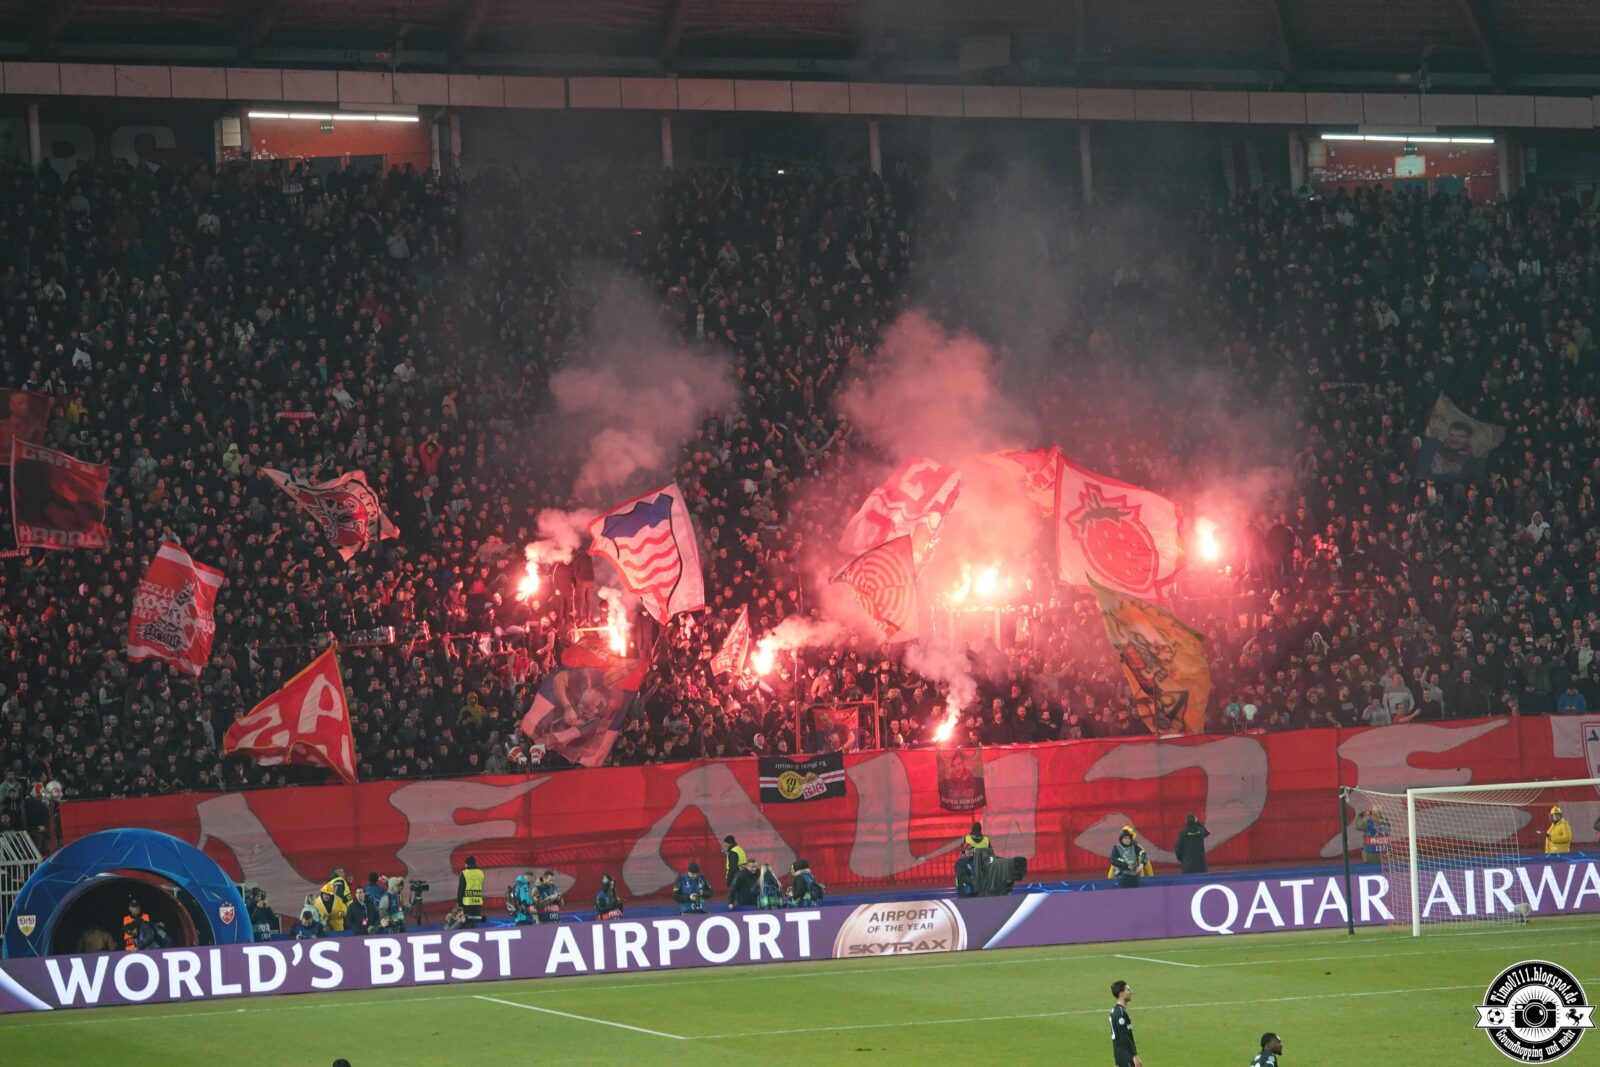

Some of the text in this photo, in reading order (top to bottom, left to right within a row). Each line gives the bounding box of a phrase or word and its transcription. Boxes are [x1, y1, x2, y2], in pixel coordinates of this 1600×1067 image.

[1191, 875, 1395, 935] QATAR
[869, 908, 938, 923] AIRPORT
[867, 922, 934, 934] OF THE YEAR
[364, 930, 522, 985] BEST
[546, 911, 821, 974] AIRPORT
[848, 939, 946, 955] SKYTRAX
